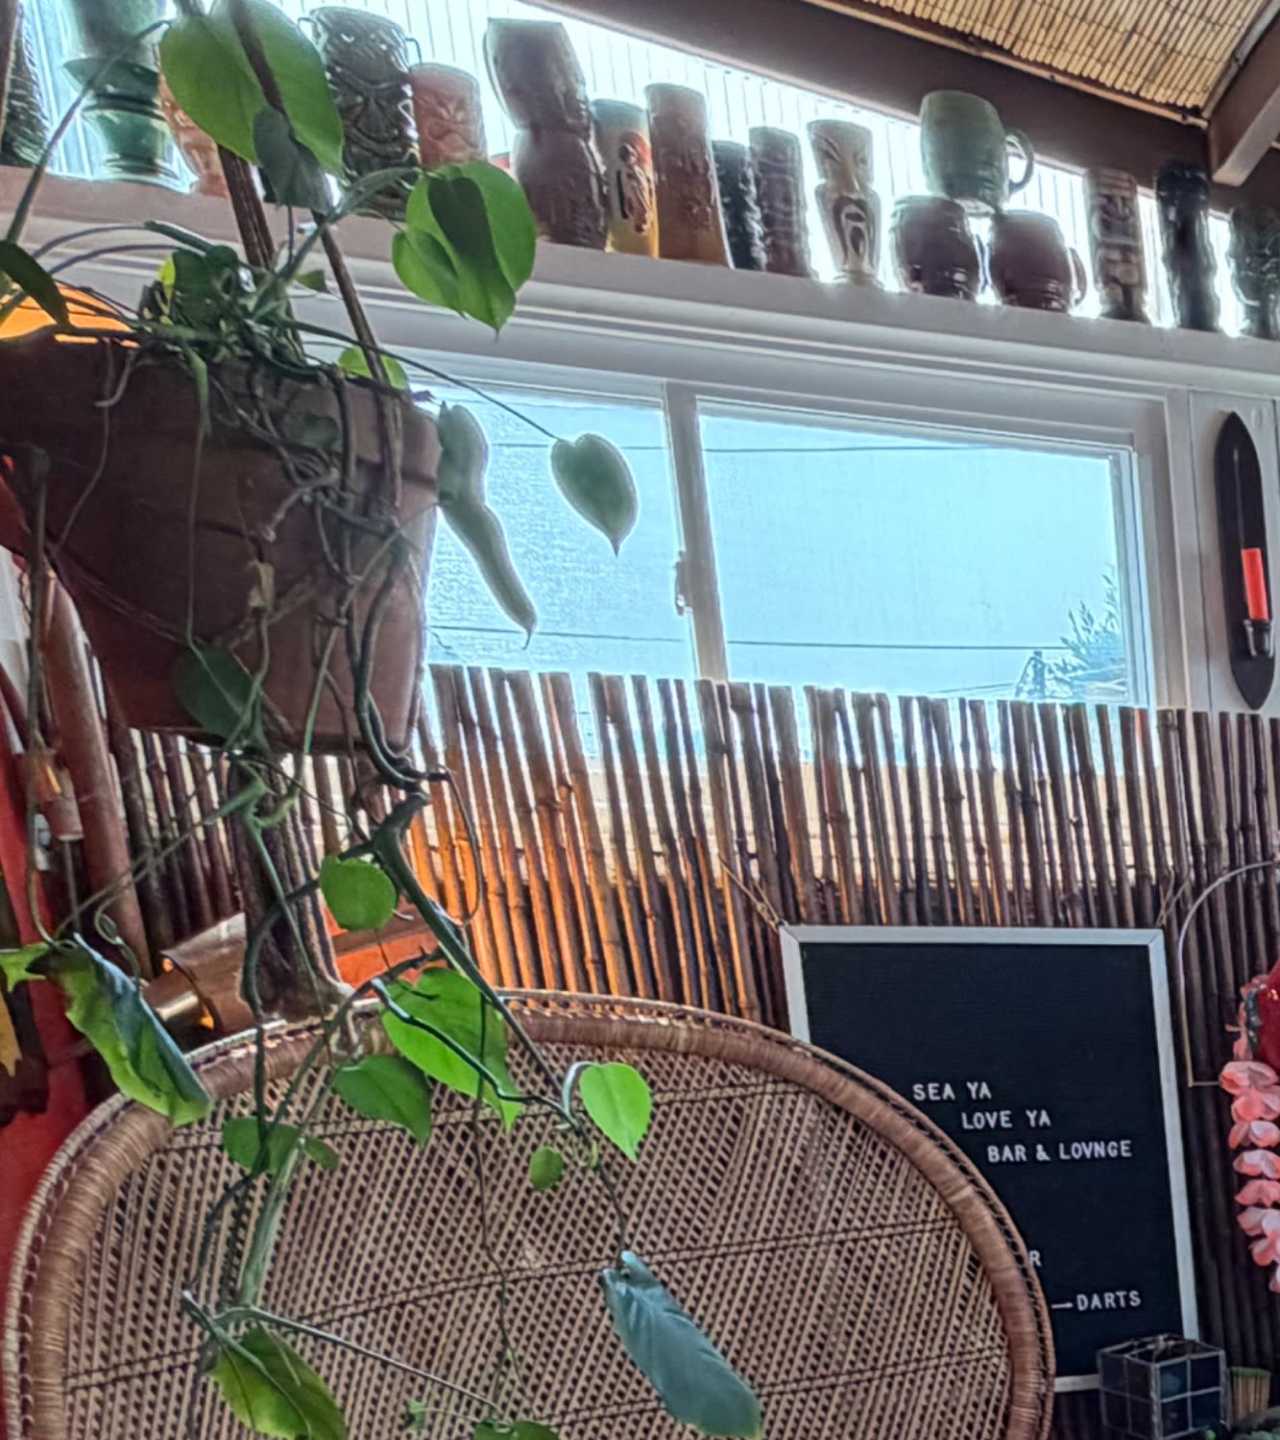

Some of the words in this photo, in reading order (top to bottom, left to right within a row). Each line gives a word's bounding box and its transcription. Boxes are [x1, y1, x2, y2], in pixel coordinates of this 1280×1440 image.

[912, 1083, 955, 1101] SEA
[966, 1081, 992, 1100] YA
[961, 1110, 1013, 1129] LOVE
[1025, 1109, 1051, 1128] YA
[987, 1144, 1027, 1163] BAR
[1035, 1143, 1051, 1161] &
